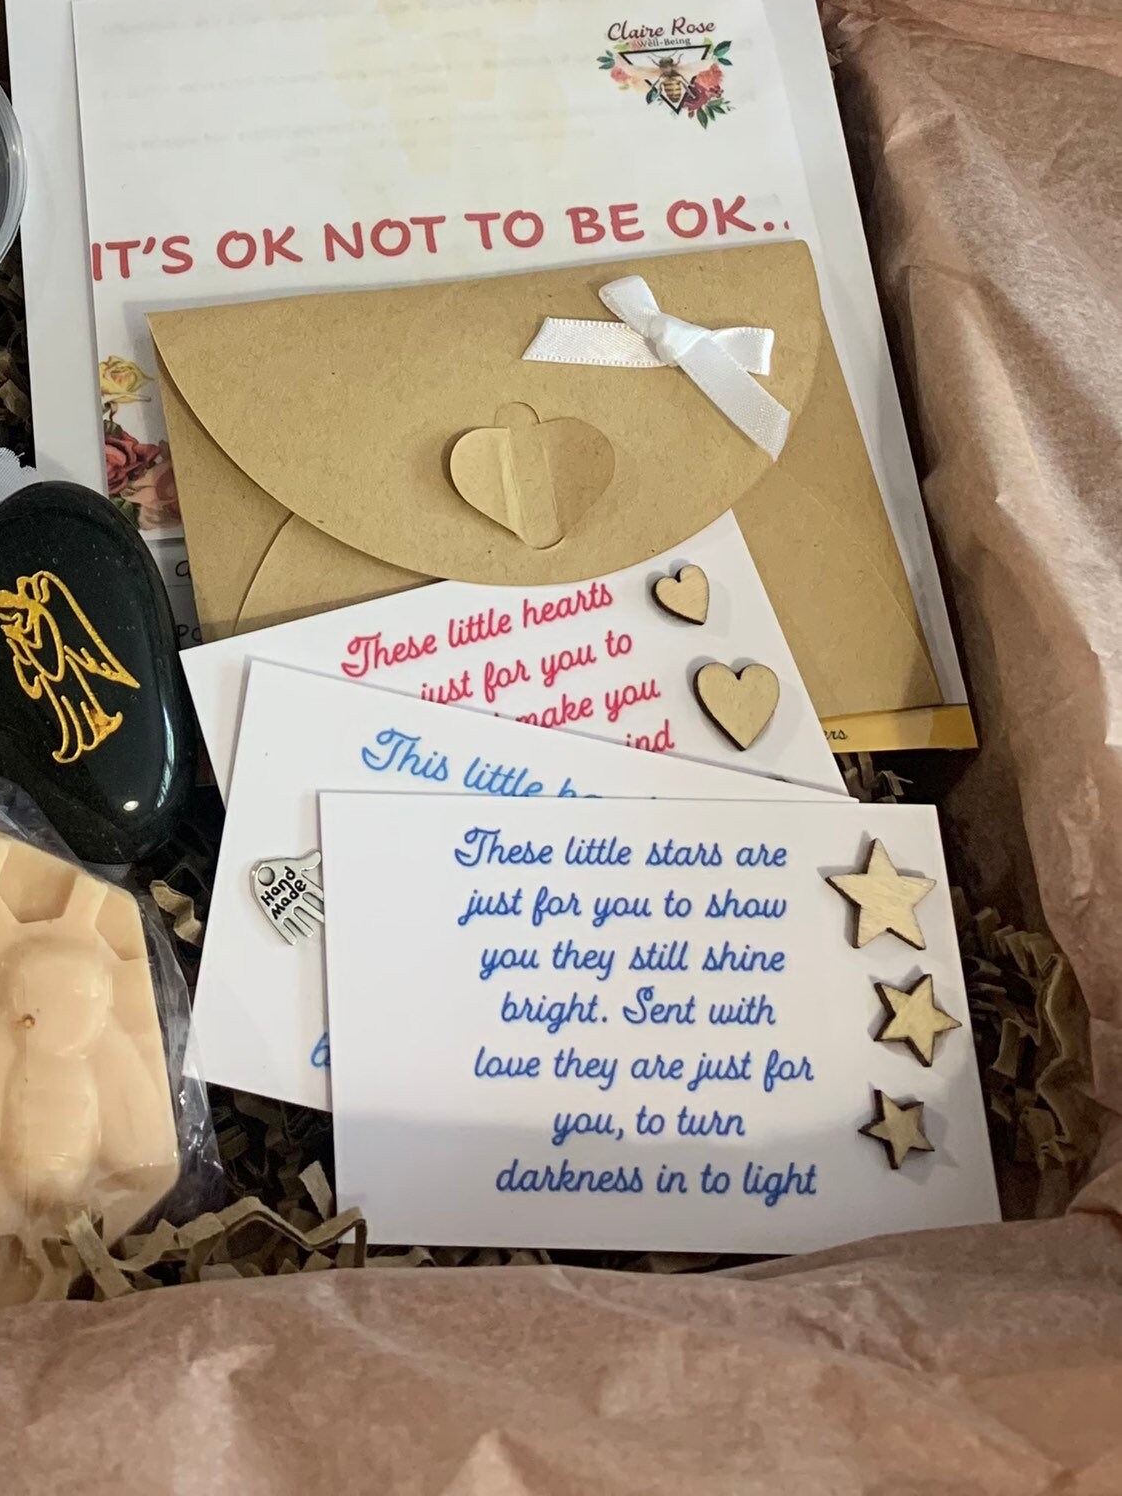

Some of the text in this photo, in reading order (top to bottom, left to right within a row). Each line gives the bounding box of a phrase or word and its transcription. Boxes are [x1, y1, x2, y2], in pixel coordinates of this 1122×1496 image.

[607, 16, 716, 42] Claire Rose
[91, 235, 194, 282] IT'S
[216, 225, 304, 270] OK
[323, 215, 447, 262] NOT
[463, 209, 545, 251] TO
[565, 203, 645, 245] BE
[340, 582, 614, 678] These little hearts
[482, 656, 532, 704] for
[539, 641, 598, 688] you
[602, 628, 635, 658] to
[604, 678, 662, 722] you
[360, 727, 450, 782] This
[462, 756, 544, 798] little
[454, 826, 787, 868] These little stars are
[261, 866, 297, 907] Hand
[270, 878, 308, 920] Made
[457, 886, 787, 928] just for you to show
[479, 939, 786, 982] you they still shine
[500, 985, 776, 1035] bright. Sent with
[474, 1046, 815, 1093] love they are just for
[551, 1105, 746, 1147] you, to turn
[495, 1158, 817, 1208] darkness in to light
